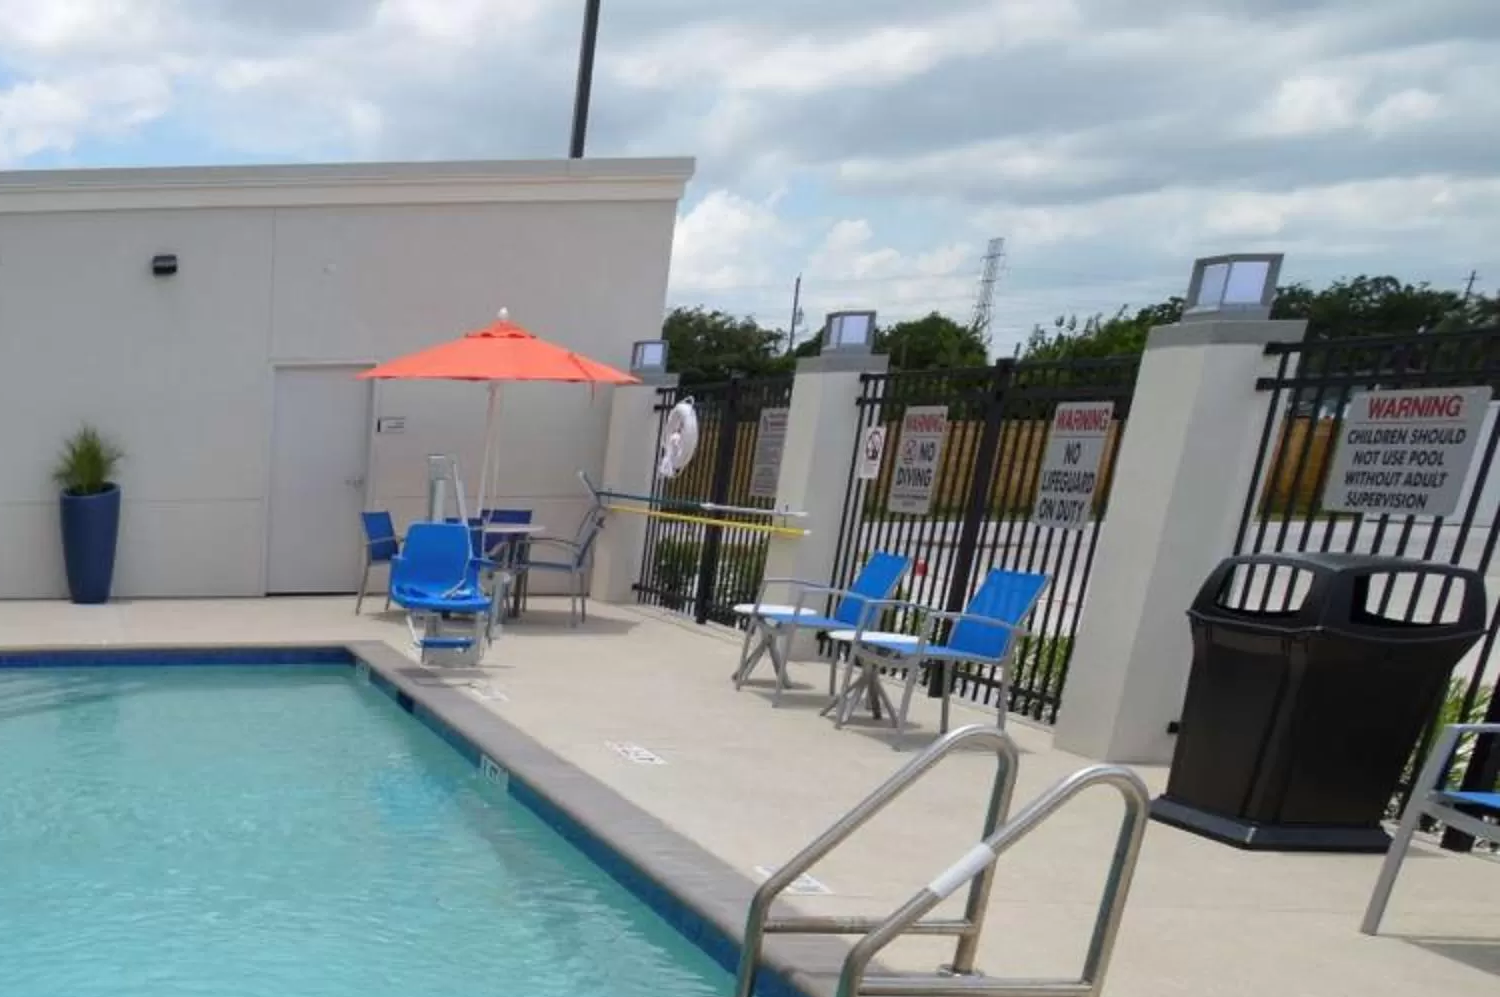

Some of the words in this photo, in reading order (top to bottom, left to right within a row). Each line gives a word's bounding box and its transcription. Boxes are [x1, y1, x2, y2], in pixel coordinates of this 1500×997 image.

[1369, 396, 1462, 419] WARNING
[905, 413, 945, 433] WARNING
[1056, 408, 1110, 431] WARNING
[1347, 429, 1408, 445] CHILDREN
[1410, 429, 1466, 444] SHOULD
[920, 441, 936, 463] NO
[1064, 441, 1082, 465] NO
[1353, 451, 1380, 466] NOT
[1382, 451, 1405, 466] USE
[1409, 451, 1445, 467] POOL
[895, 466, 933, 487] DIVING
[1041, 470, 1096, 495] LIFEGUARD
[1344, 471, 1403, 487] WITHOUT
[1404, 473, 1446, 487] ADULT
[1038, 498, 1055, 521] ON
[1056, 499, 1086, 523] DUTY
[1345, 492, 1428, 508] SUPERVISION
